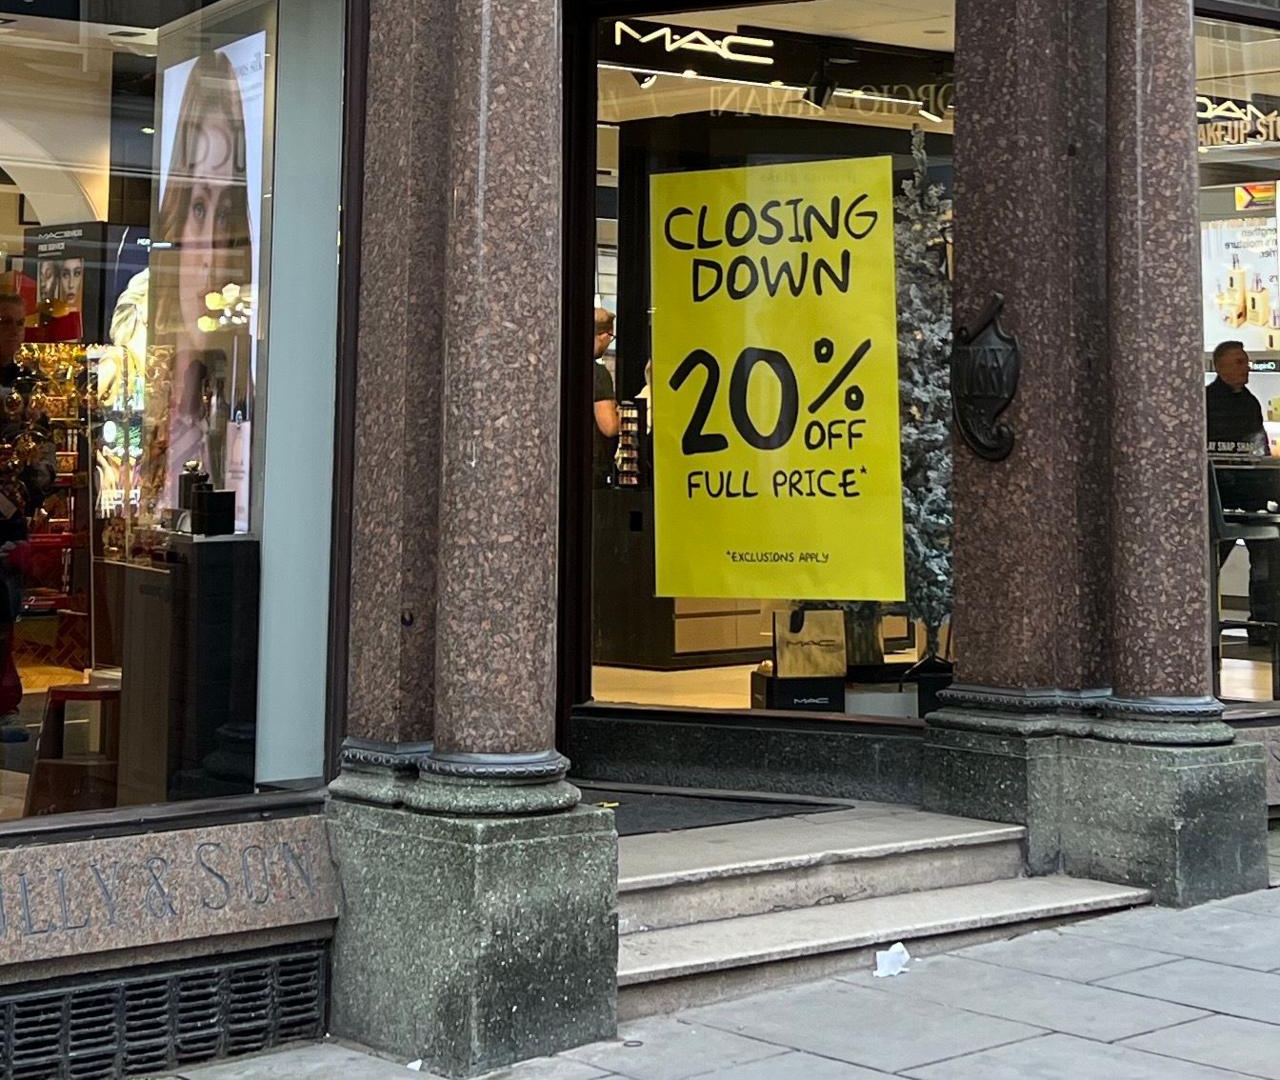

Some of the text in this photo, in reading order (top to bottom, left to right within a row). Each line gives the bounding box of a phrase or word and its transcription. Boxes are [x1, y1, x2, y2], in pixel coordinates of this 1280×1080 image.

[664, 193, 878, 251] CLOSING
[692, 250, 850, 302] DOWN
[669, 337, 872, 456] 20%
[804, 419, 868, 451] OFF
[687, 470, 758, 499] FULL
[798, 551, 829, 563] APPLY
[145, 856, 179, 919] &
[196, 840, 317, 912] SON
